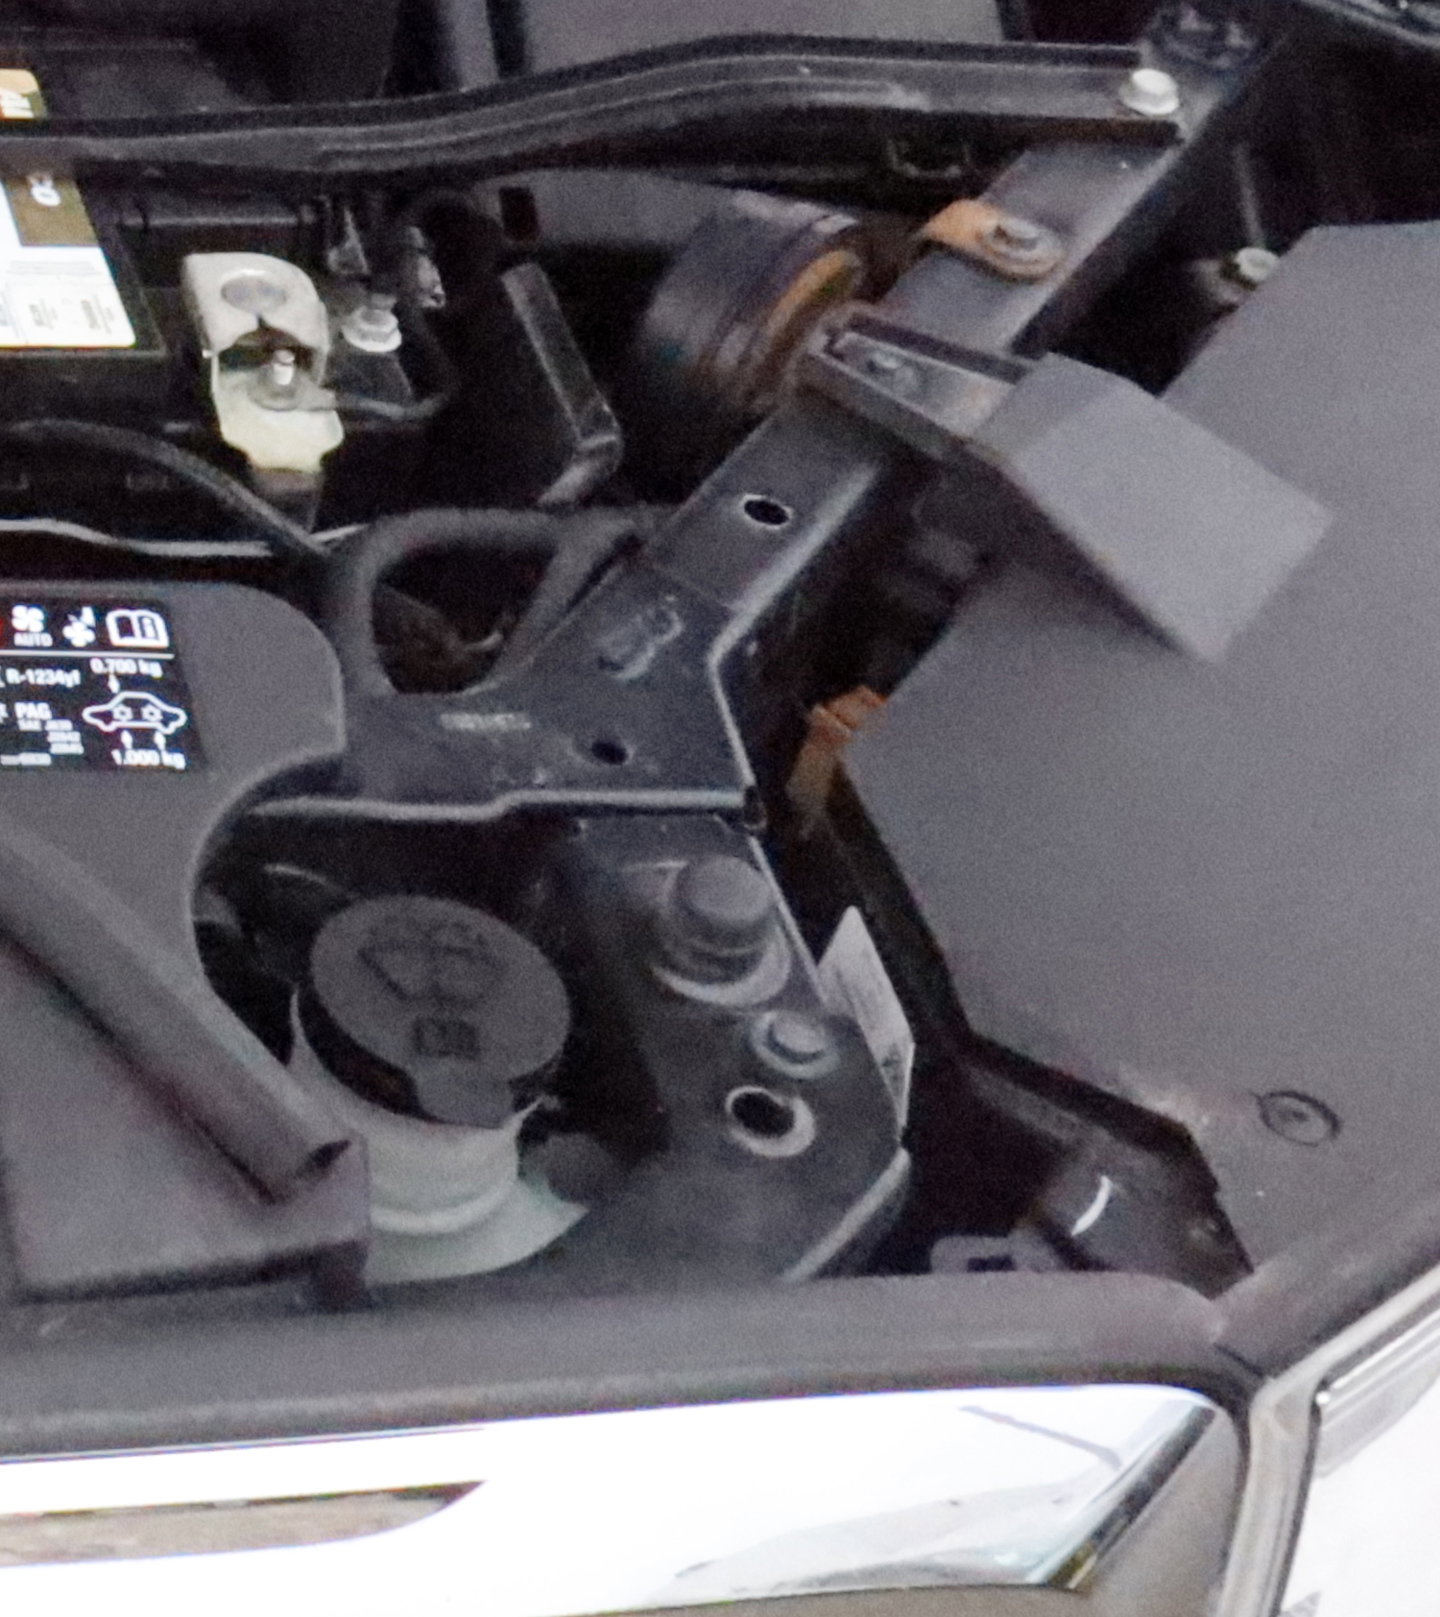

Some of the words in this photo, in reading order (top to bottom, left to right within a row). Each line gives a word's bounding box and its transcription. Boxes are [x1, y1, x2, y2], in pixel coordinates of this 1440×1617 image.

[14, 632, 53, 647] AUTO
[90, 658, 137, 675] 0.700
[138, 659, 163, 679] kg
[14, 702, 52, 720] PAG
[161, 750, 186, 770] kg
